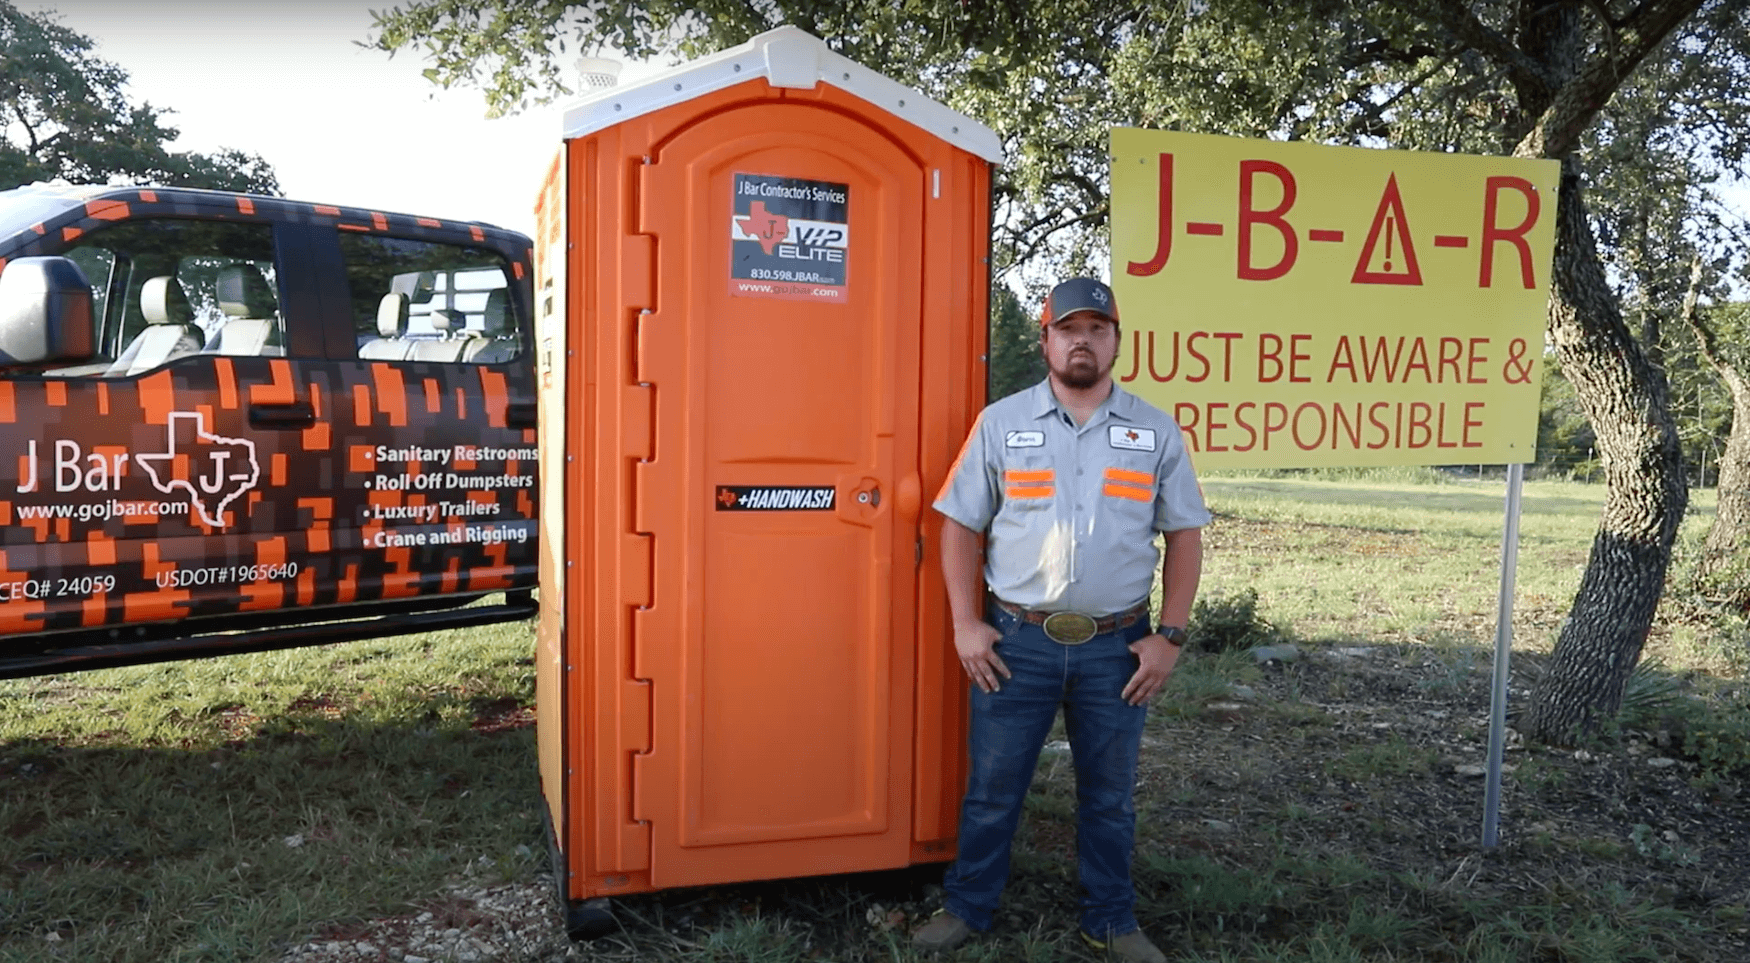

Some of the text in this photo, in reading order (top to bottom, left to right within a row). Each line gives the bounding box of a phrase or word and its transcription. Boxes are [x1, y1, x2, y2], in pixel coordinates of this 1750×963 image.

[737, 181, 846, 204] J Bar Contractor's Services
[795, 226, 843, 247] VIP
[778, 244, 843, 262] ELITE
[1120, 330, 1535, 385] JUST BE AWARE &
[1175, 401, 1486, 453] RESPONSIBLE
[376, 445, 539, 465] Sanitary Restrooms
[17, 440, 129, 493] J Bar
[375, 472, 534, 491] Roll Off Dumpsters
[17, 500, 189, 521] www.gojbar.com
[374, 500, 500, 521] Luxury Trailers
[374, 525, 528, 547] Crane and Rigging
[57, 574, 116, 597] 24059
[155, 561, 298, 588] USDOT#1965640
